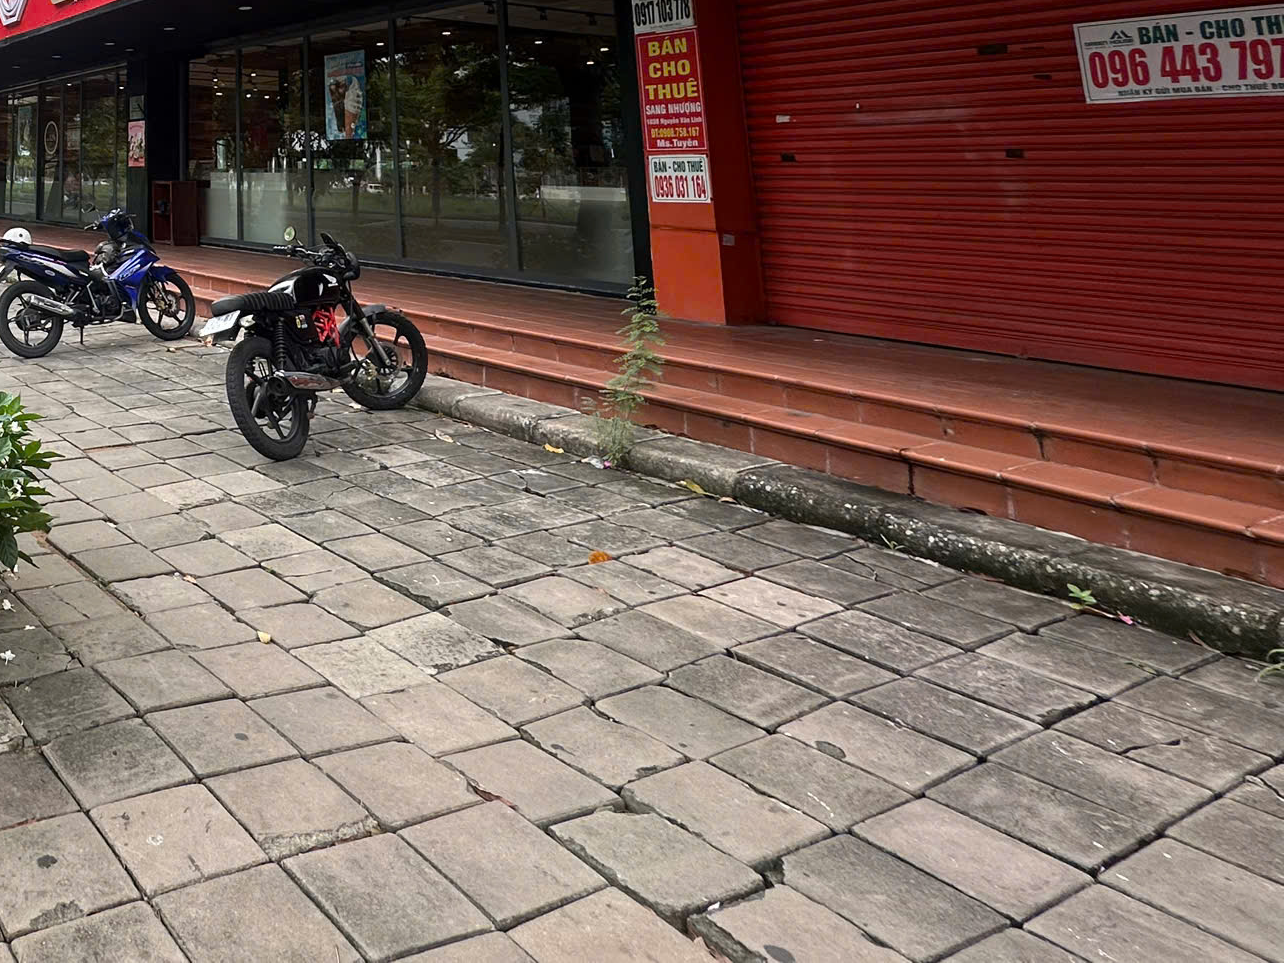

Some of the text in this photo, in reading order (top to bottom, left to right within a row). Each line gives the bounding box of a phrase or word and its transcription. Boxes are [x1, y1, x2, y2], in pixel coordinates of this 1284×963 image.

[634, 1, 655, 27] 0917
[1137, 22, 1180, 45] BÁN
[1199, 17, 1245, 40] CHO
[1251, 14, 1284, 36] TH
[647, 36, 688, 57] BÁN
[648, 59, 691, 78] CHO
[1088, 38, 1284, 89] 096 443 797
[645, 78, 698, 100] THUÊ
[1172, 85, 1193, 93] MUA
[1221, 83, 1241, 92] CHO
[645, 104, 666, 115] SANG
[653, 158, 667, 173] BÁN
[672, 160, 686, 173] CHO
[686, 157, 703, 173] THUÊ
[654, 174, 707, 198] 0936 031 164
